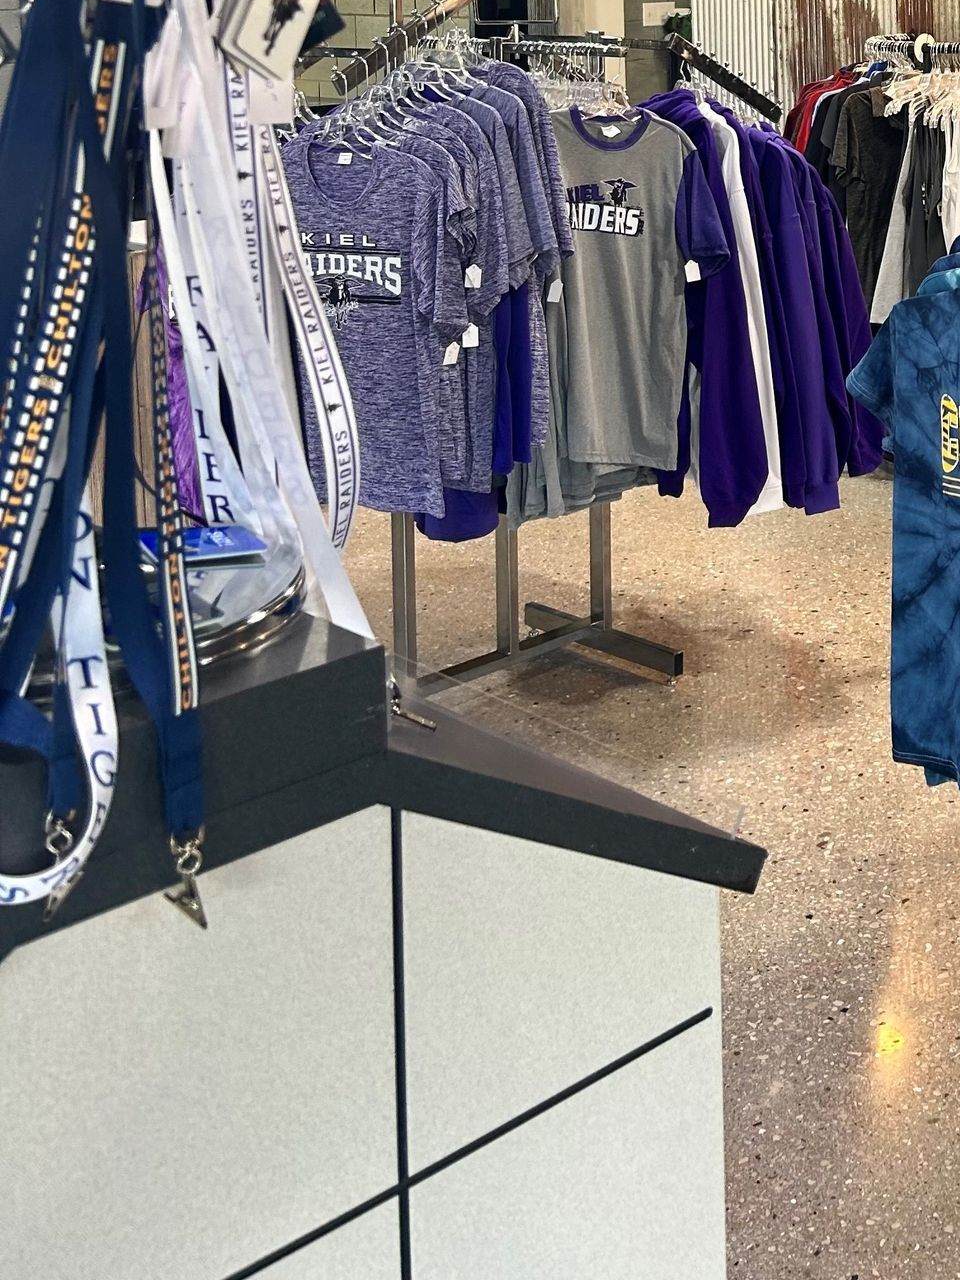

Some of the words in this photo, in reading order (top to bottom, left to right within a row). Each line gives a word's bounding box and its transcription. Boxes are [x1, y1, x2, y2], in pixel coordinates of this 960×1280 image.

[301, 232, 377, 247] KIEL
[303, 253, 402, 296] AIDERS
[315, 345, 334, 385] KIEL
[2, 398, 48, 528] TIGERS
[335, 430, 353, 511] RAIDERS
